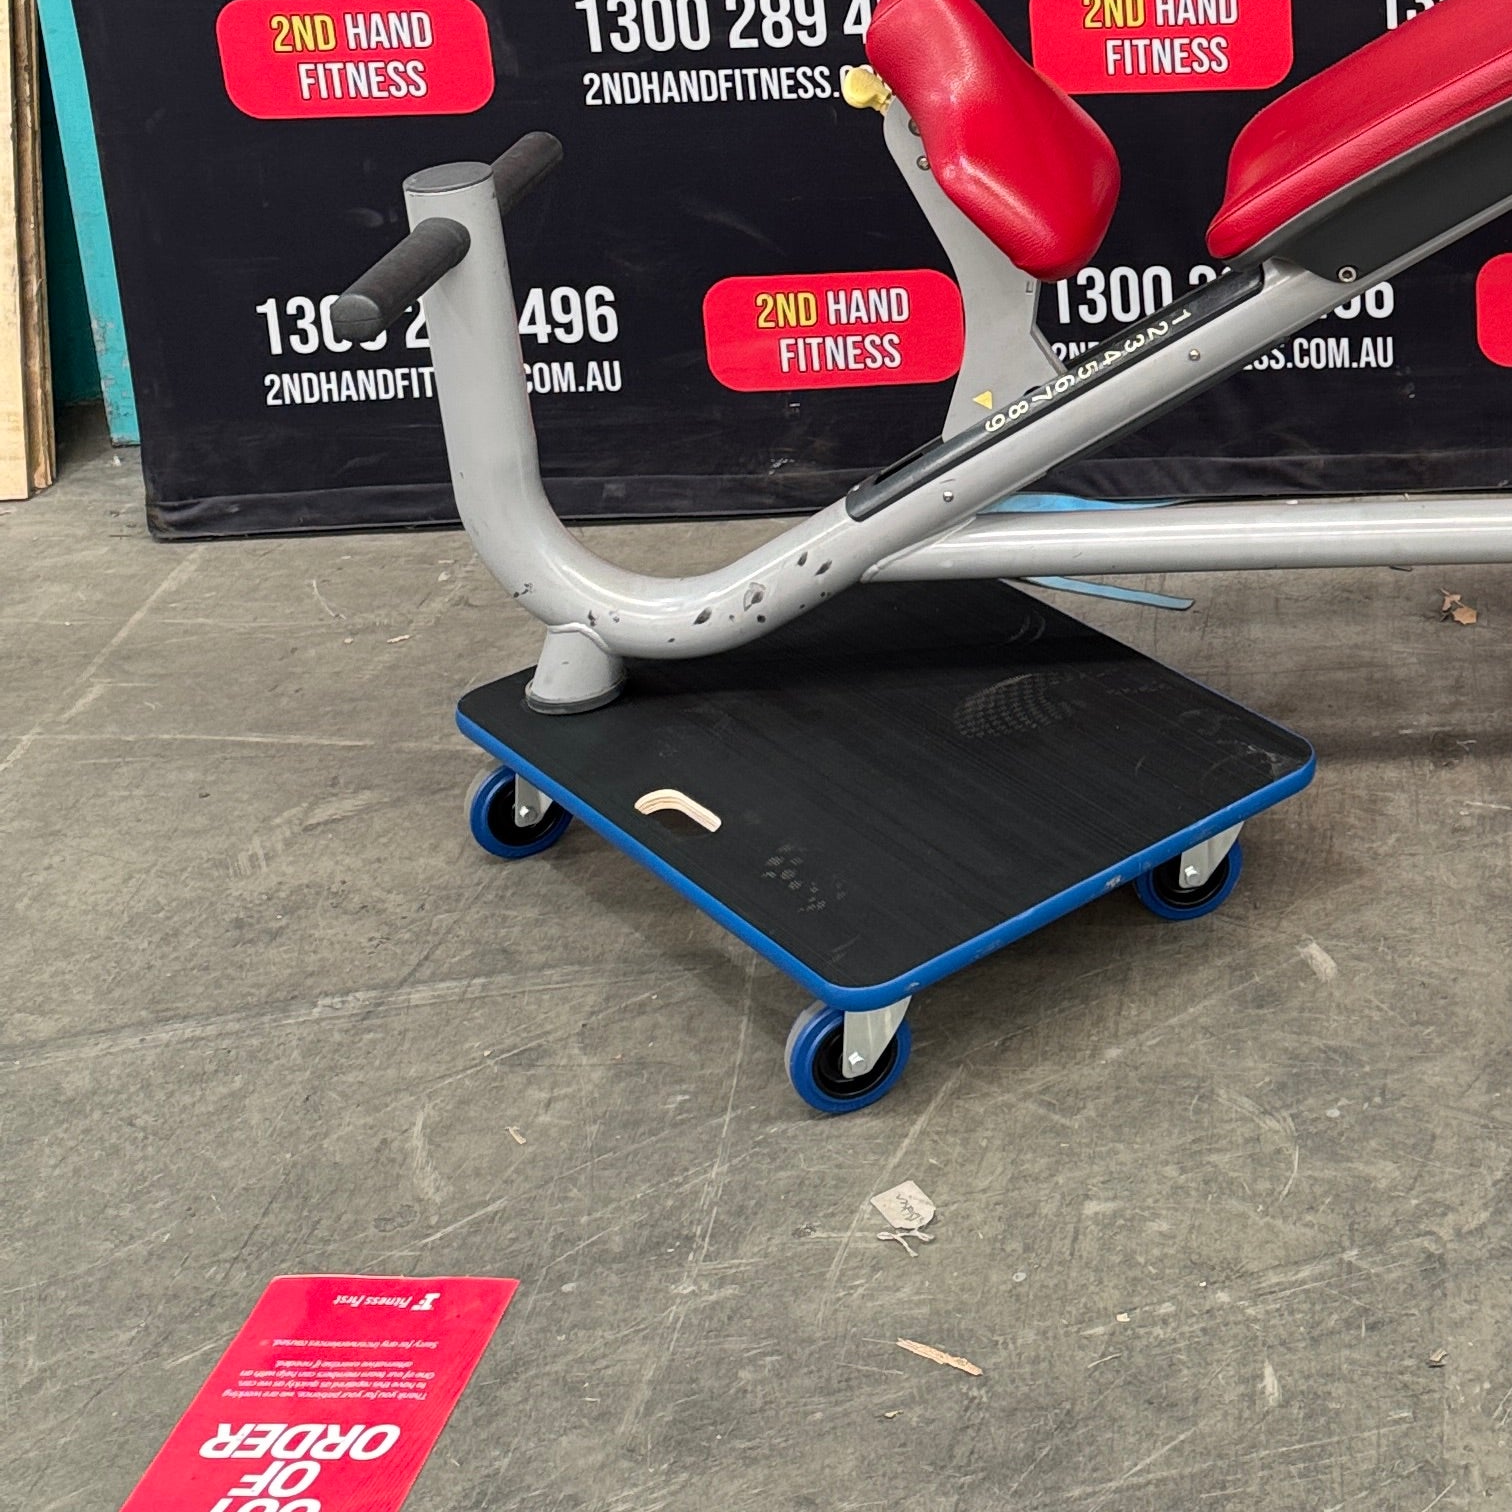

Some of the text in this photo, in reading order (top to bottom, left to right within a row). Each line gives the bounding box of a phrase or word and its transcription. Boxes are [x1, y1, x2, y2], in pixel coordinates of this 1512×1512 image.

[270, 11, 433, 52] 2ND HAND
[1106, 36, 1229, 75] FITNESS
[298, 60, 427, 100] FITNESS
[756, 287, 909, 328] 2ND HAND
[1056, 265, 1174, 325] 1300
[517, 286, 620, 344] 496
[1172, 309, 1191, 325] 1
[1124, 334, 1145, 352] 3
[1147, 321, 1169, 340] 2
[779, 333, 902, 373] FITNESS
[1103, 349, 1121, 366] 4
[1055, 374, 1074, 392] 6
[1078, 363, 1098, 379] 5
[1032, 385, 1053, 402] 7
[985, 414, 1005, 432] 9
[1008, 401, 1029, 419] 8
[198, 1423, 401, 1461] ORDER
[226, 1460, 321, 1498] OF
